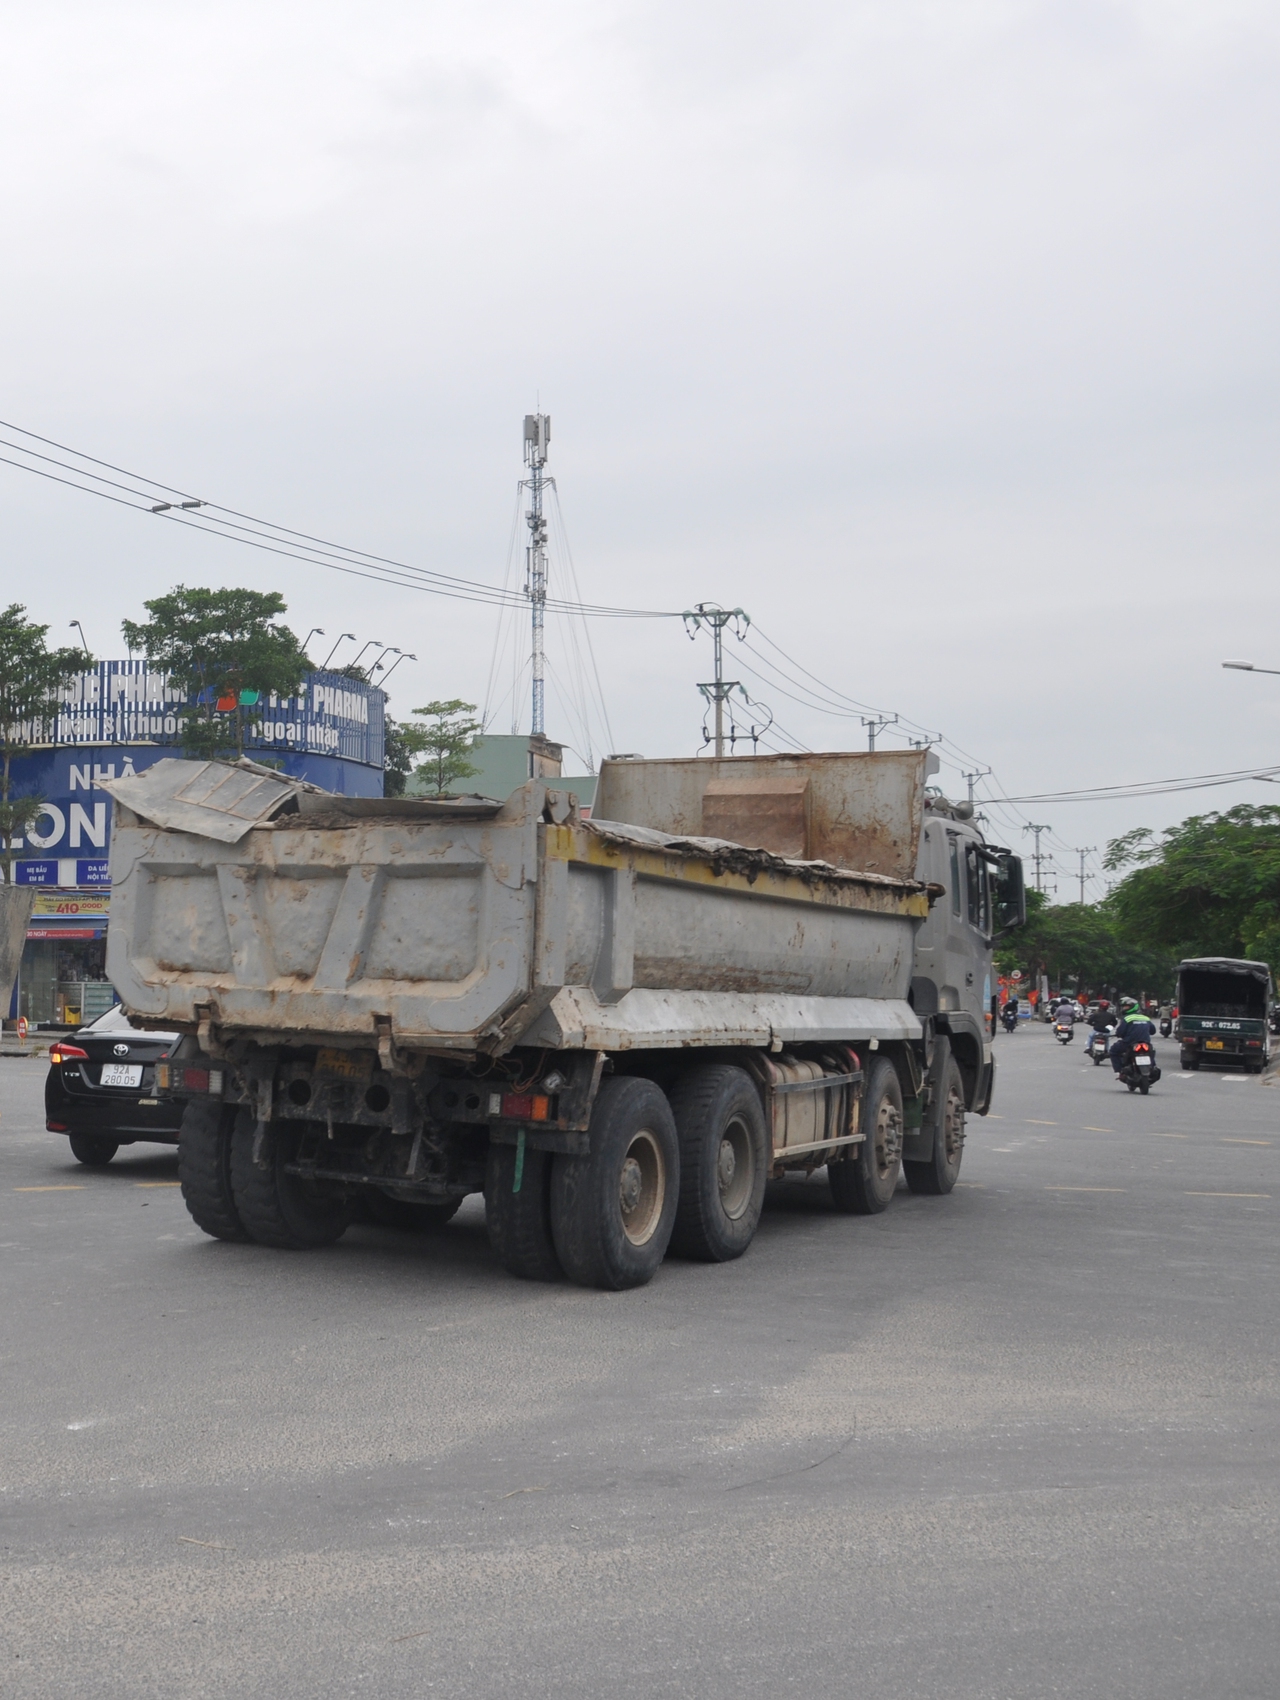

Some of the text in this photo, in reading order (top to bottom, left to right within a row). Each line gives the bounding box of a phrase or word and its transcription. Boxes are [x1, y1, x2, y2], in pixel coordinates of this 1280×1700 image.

[313, 684, 369, 724] PHARMA
[2, 803, 113, 849] LON
[104, 1075, 136, 1085] 280.05
[113, 1065, 130, 1075] 92A
